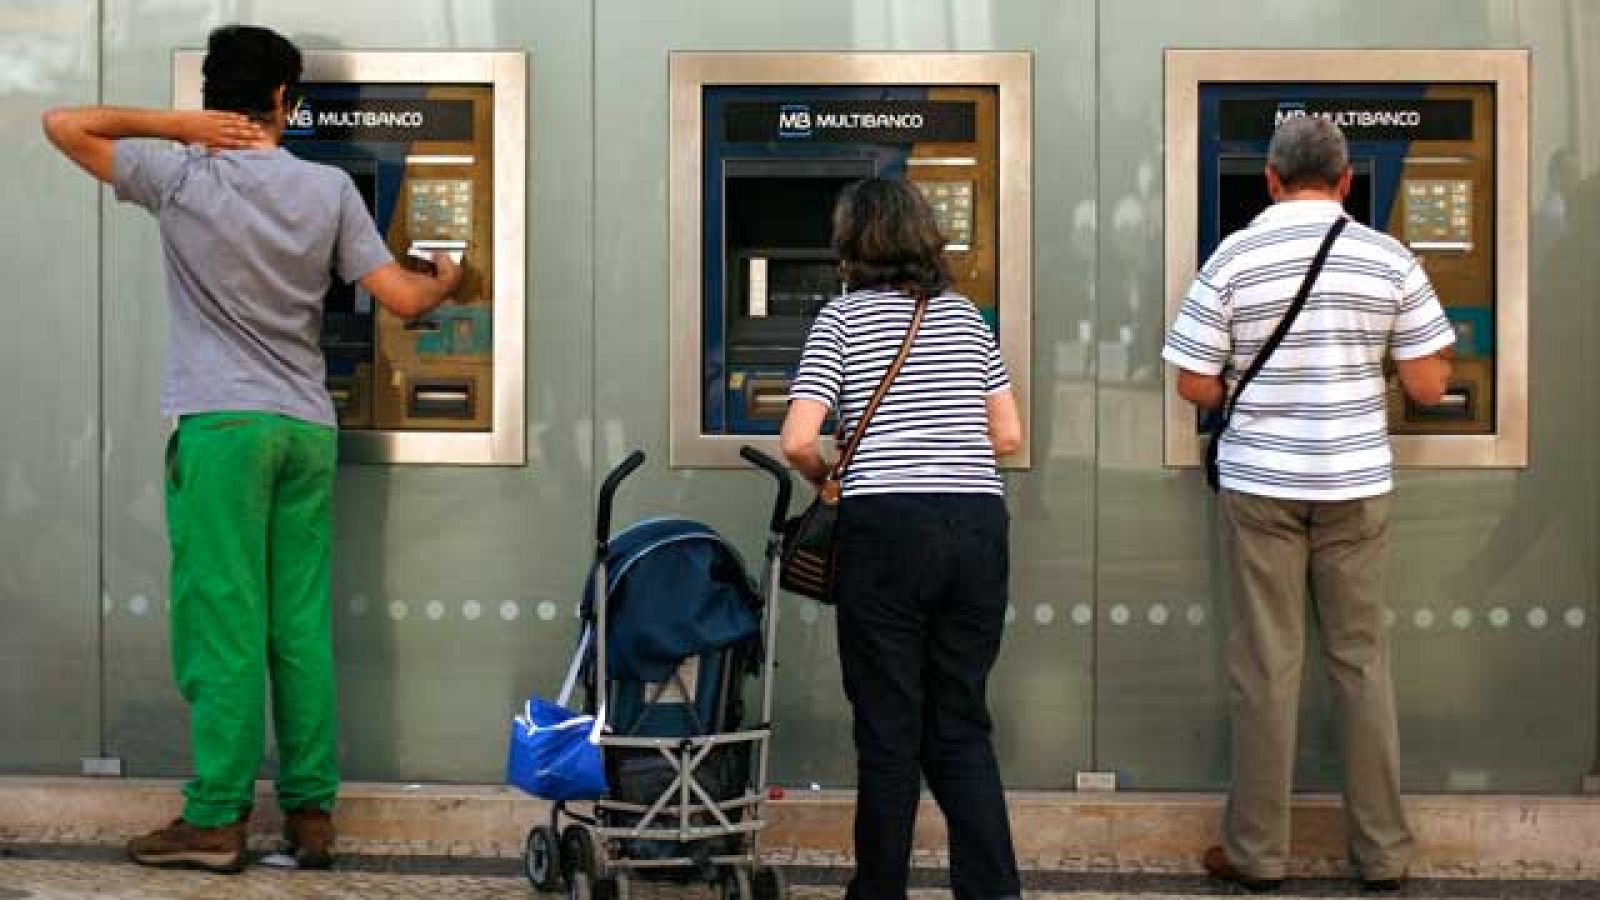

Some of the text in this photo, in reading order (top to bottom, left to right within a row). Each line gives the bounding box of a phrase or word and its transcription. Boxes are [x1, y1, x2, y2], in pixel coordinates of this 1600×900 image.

[318, 111, 424, 127] MULTIBANCO
[779, 111, 924, 128] MB MULTIBANCO
